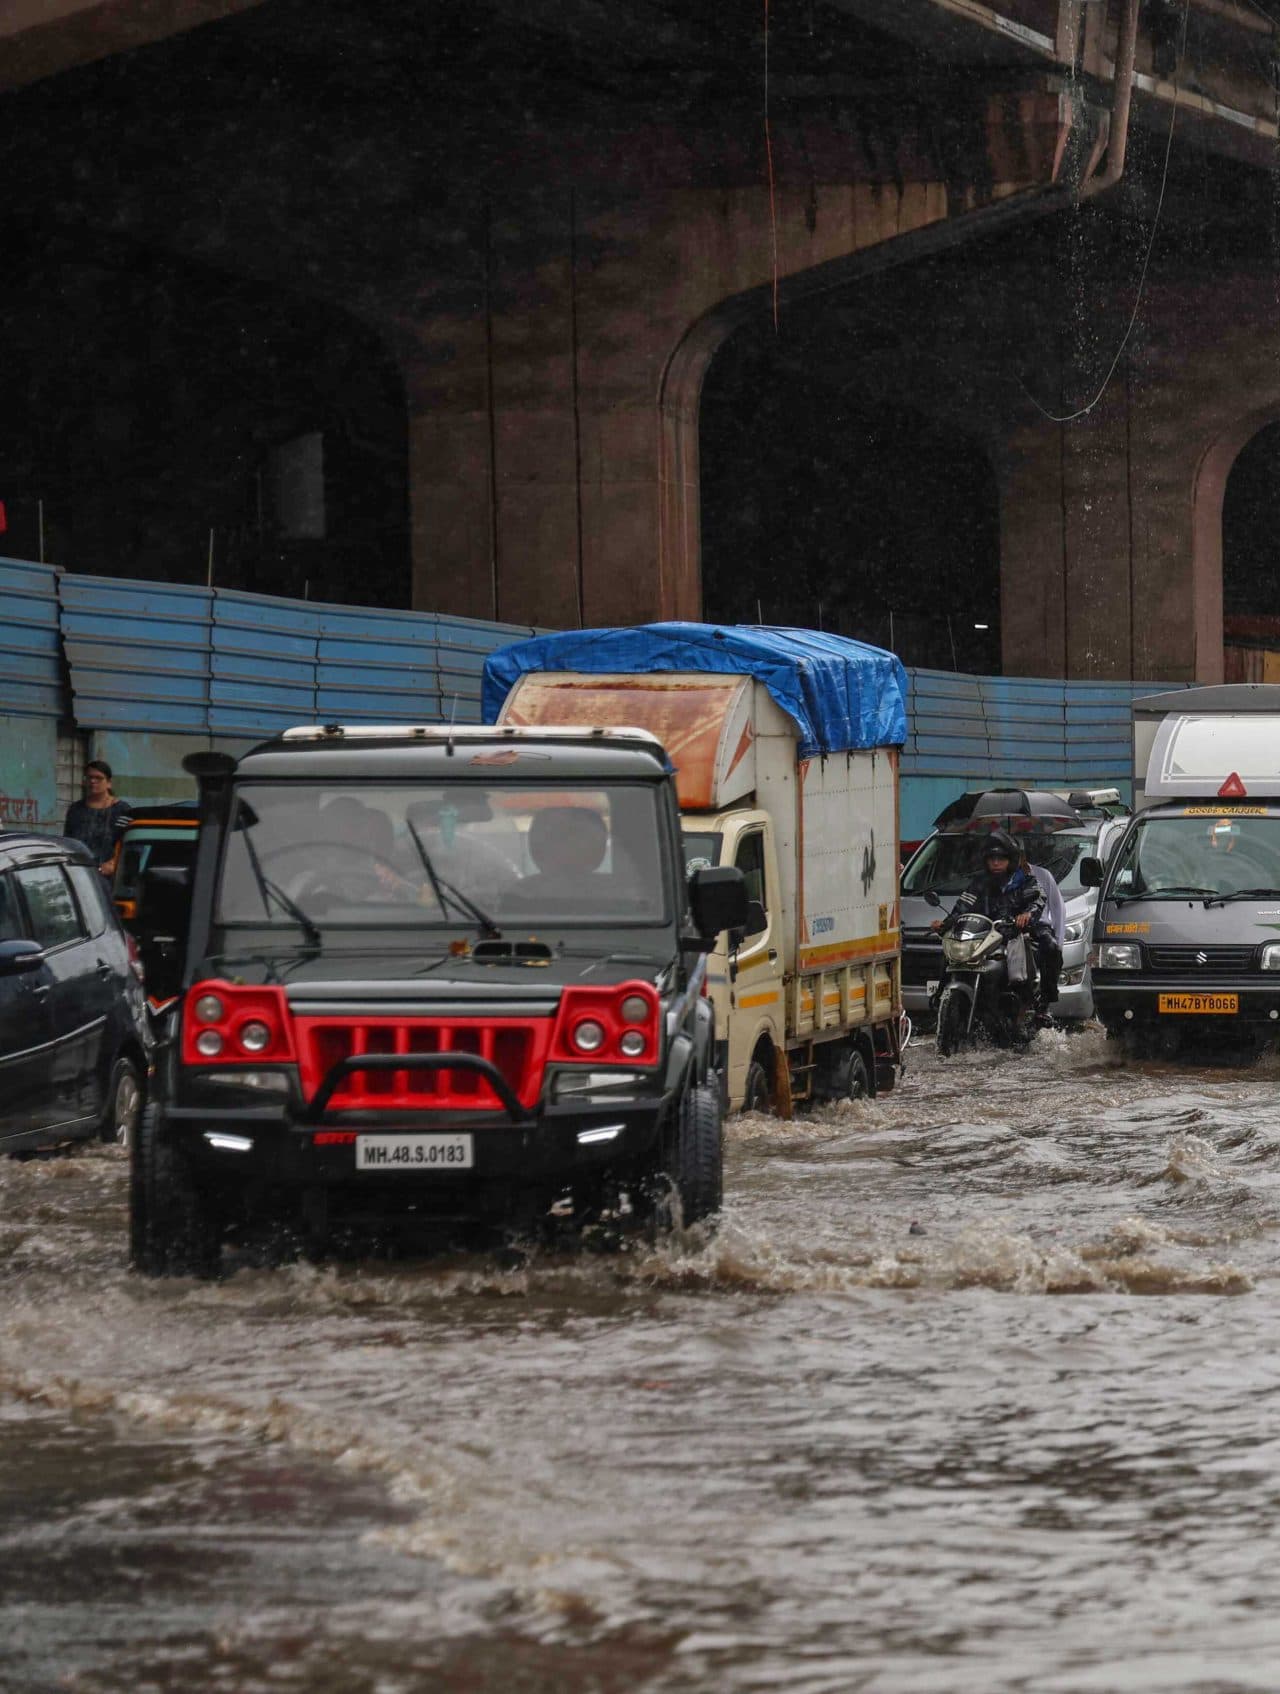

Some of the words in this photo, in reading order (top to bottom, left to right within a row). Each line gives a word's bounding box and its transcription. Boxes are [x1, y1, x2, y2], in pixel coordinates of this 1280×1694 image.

[1222, 807, 1264, 815] CARRIER
[1166, 997, 1236, 1009] MH47BY8066
[364, 1145, 465, 1164] MH.48.S.0183
